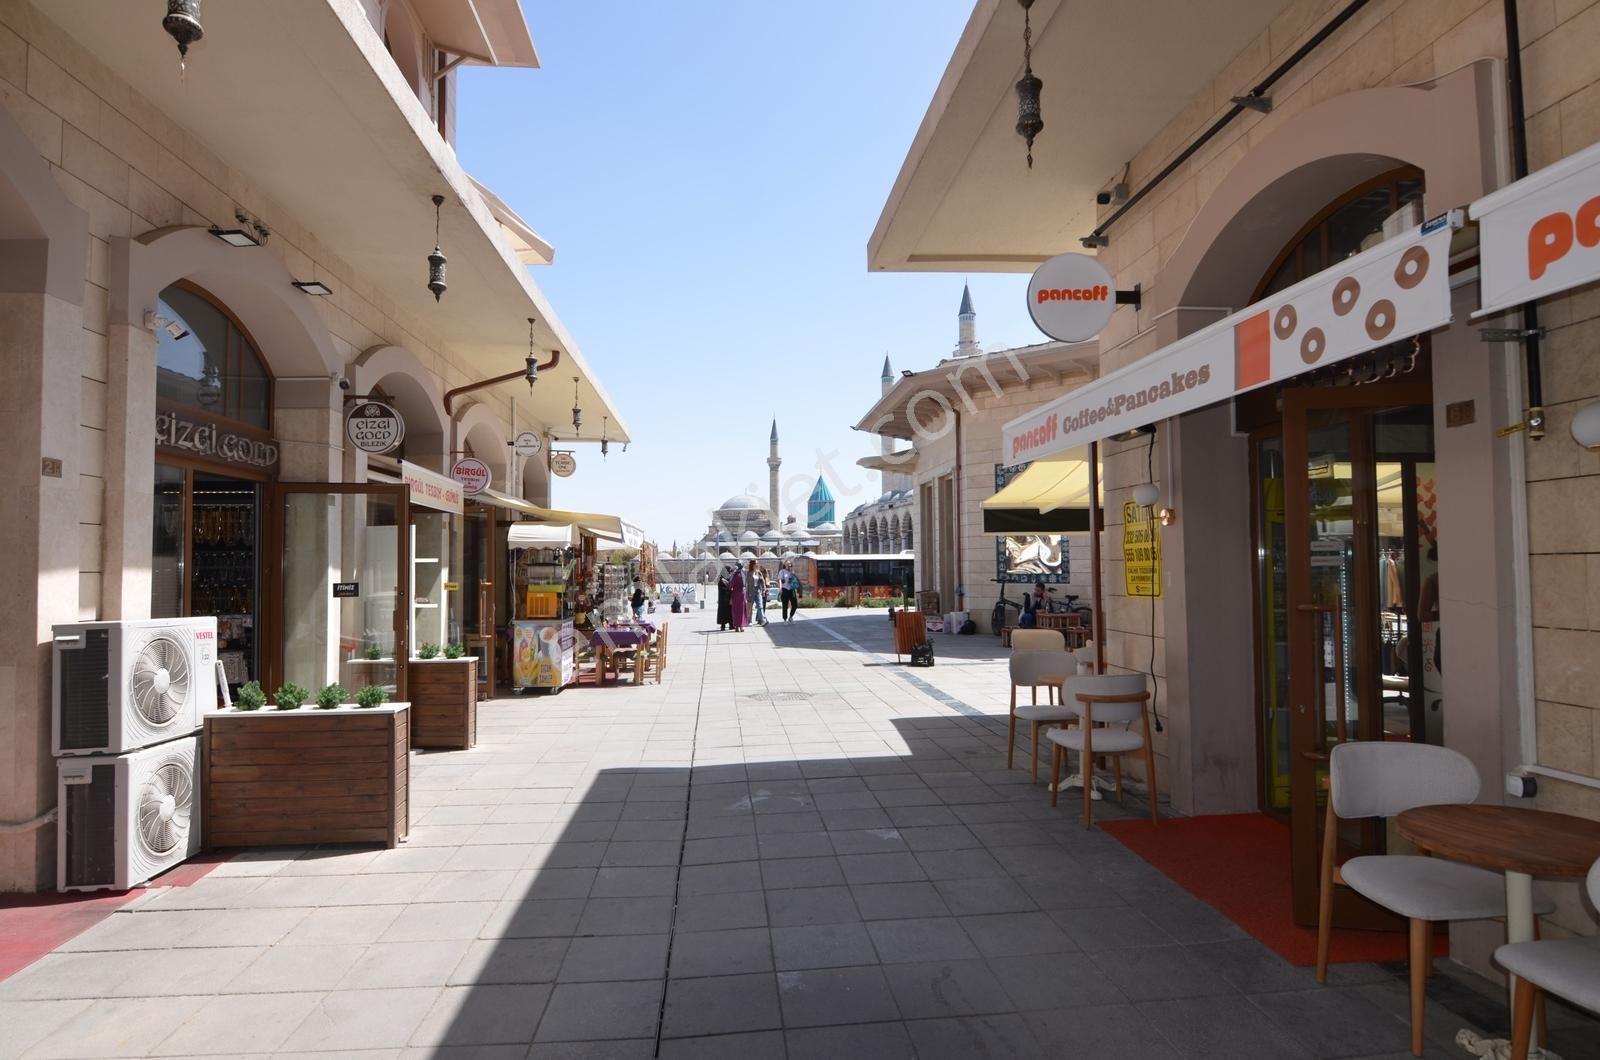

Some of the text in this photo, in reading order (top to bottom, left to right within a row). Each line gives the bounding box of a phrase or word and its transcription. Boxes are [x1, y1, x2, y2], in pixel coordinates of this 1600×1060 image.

[1037, 285, 1109, 304] pancoff
[1012, 363, 1211, 459] pancoff Coffee&Pancakes
[355, 430, 391, 440] GOLD
[218, 434, 277, 466] GOLD
[456, 466, 486, 477] BİRGÜL
[196, 631, 214, 640] VESTEL
